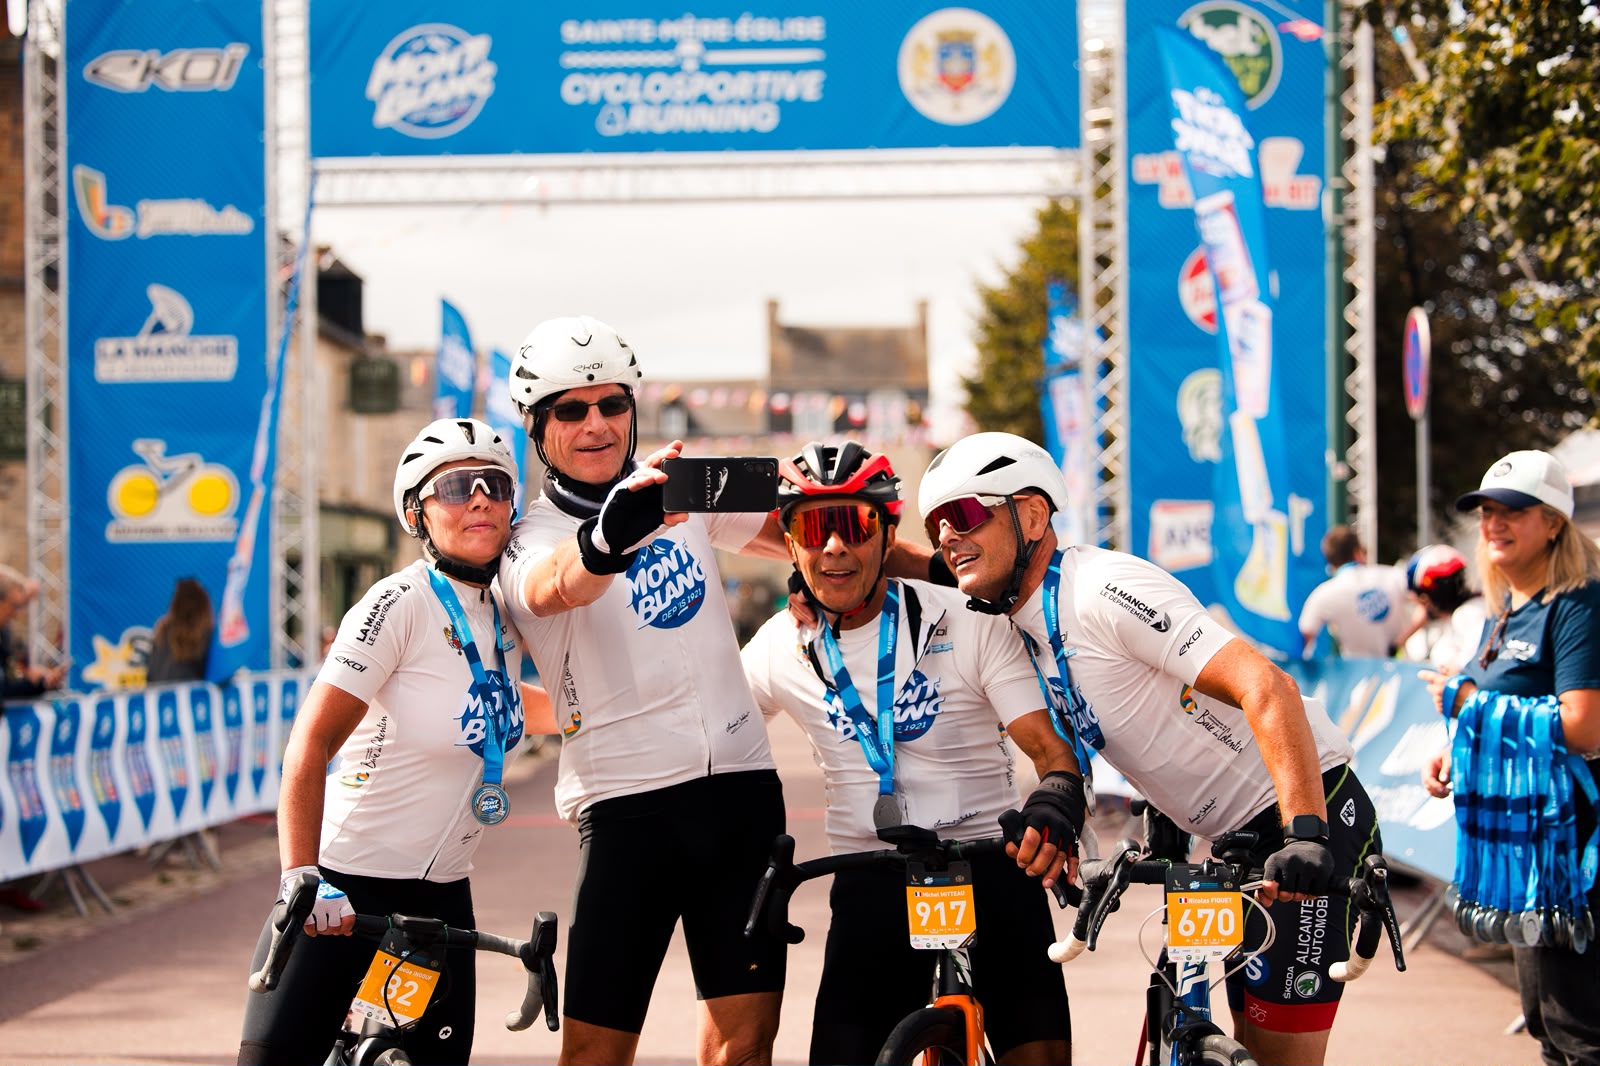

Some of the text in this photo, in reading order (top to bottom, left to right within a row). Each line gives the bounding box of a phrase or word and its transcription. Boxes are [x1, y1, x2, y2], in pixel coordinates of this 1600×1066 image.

[561, 69, 826, 105] CYCLOSPORTIVE
[628, 101, 781, 134] RUNNING
[627, 537, 690, 609] MONT
[637, 558, 708, 630] BLANC
[686, 588, 703, 606] 1921
[1100, 588, 1152, 626] LE DÉPARTEMENT
[1105, 582, 1159, 620] LA MANCHE
[356, 587, 396, 643] LA MANCHE
[367, 591, 403, 647] LE DÉPARTEMENT
[903, 721, 927, 732] 1921
[1195, 709, 1212, 732] Baie
[916, 900, 967, 927] 917
[1177, 908, 1235, 937] 670
[1296, 899, 1315, 965] ALICANTE
[380, 974, 419, 1007] 82
[1283, 966, 1295, 999] ŠKODA
